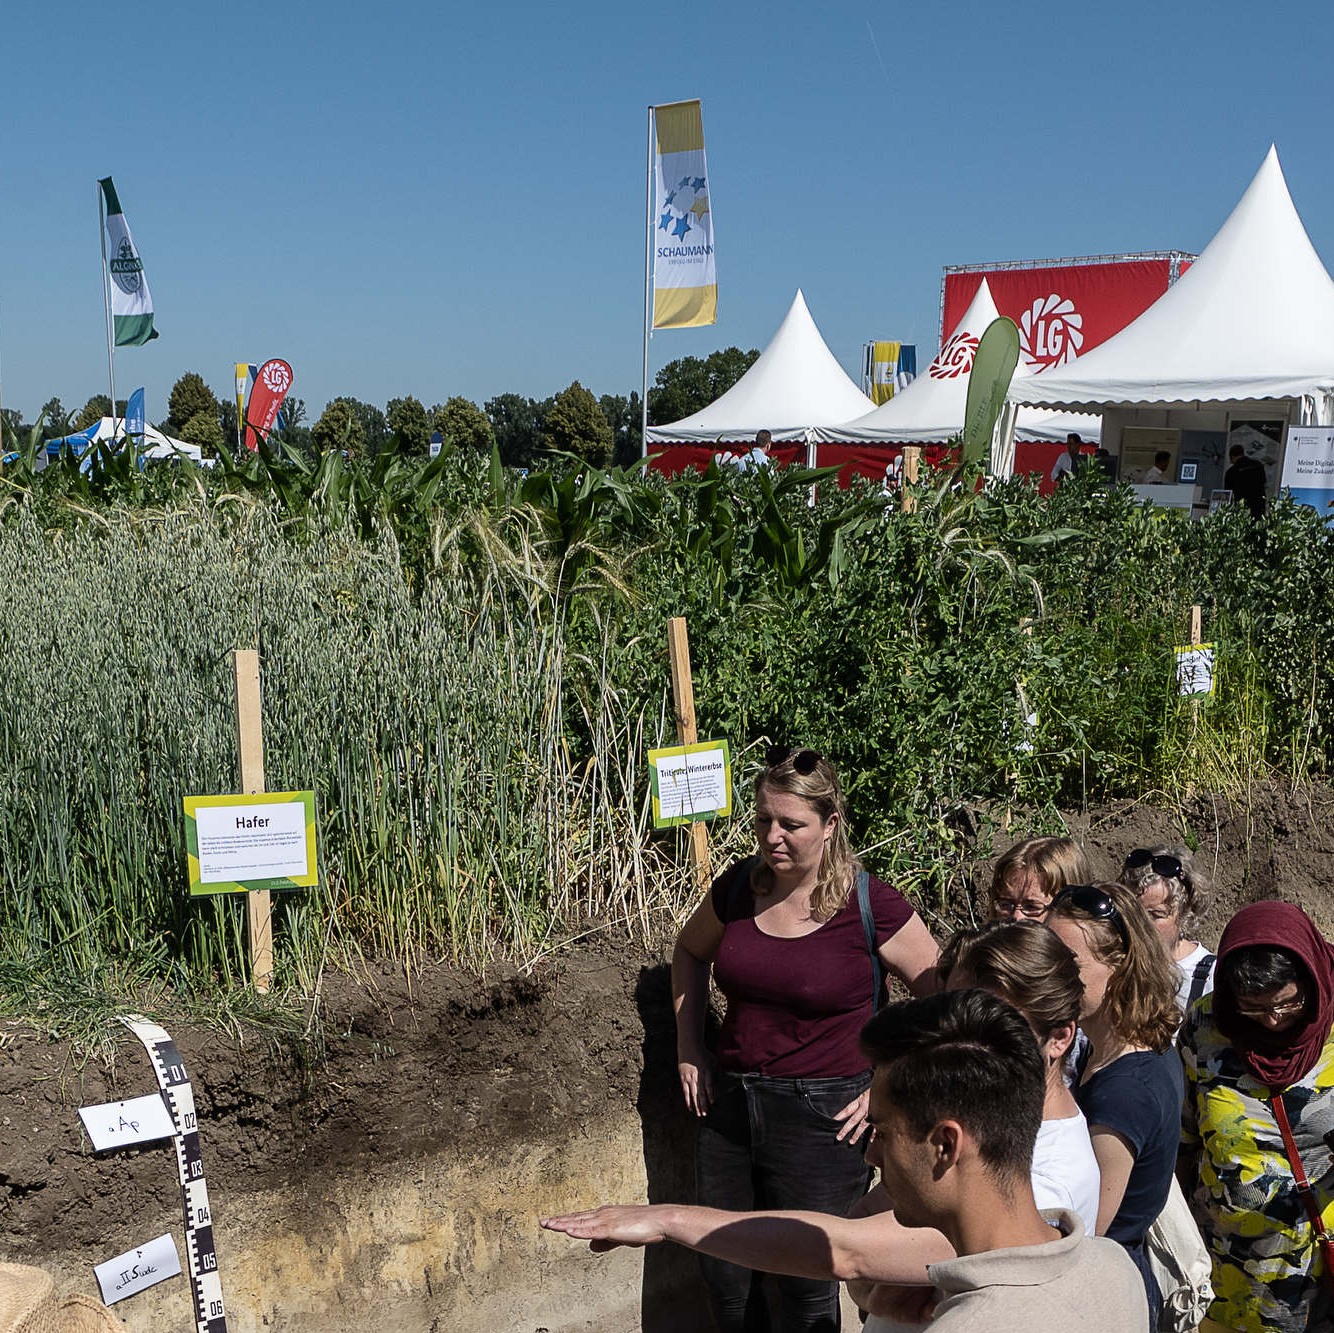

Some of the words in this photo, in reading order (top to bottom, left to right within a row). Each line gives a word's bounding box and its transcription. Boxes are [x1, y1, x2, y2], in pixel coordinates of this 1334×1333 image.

[658, 244, 713, 257] SCHAUMANN
[1036, 320, 1063, 357] LG
[944, 346, 967, 367] LG
[271, 370, 282, 384] LG
[688, 762, 722, 773] Wintererbse
[235, 816, 270, 829] Hafer
[171, 1065, 188, 1081] 01
[184, 1112, 196, 1130] 02
[191, 1160, 203, 1176] 03
[198, 1206, 210, 1223] 04
[203, 1252, 216, 1269] 05
[210, 1300, 223, 1316] 06
